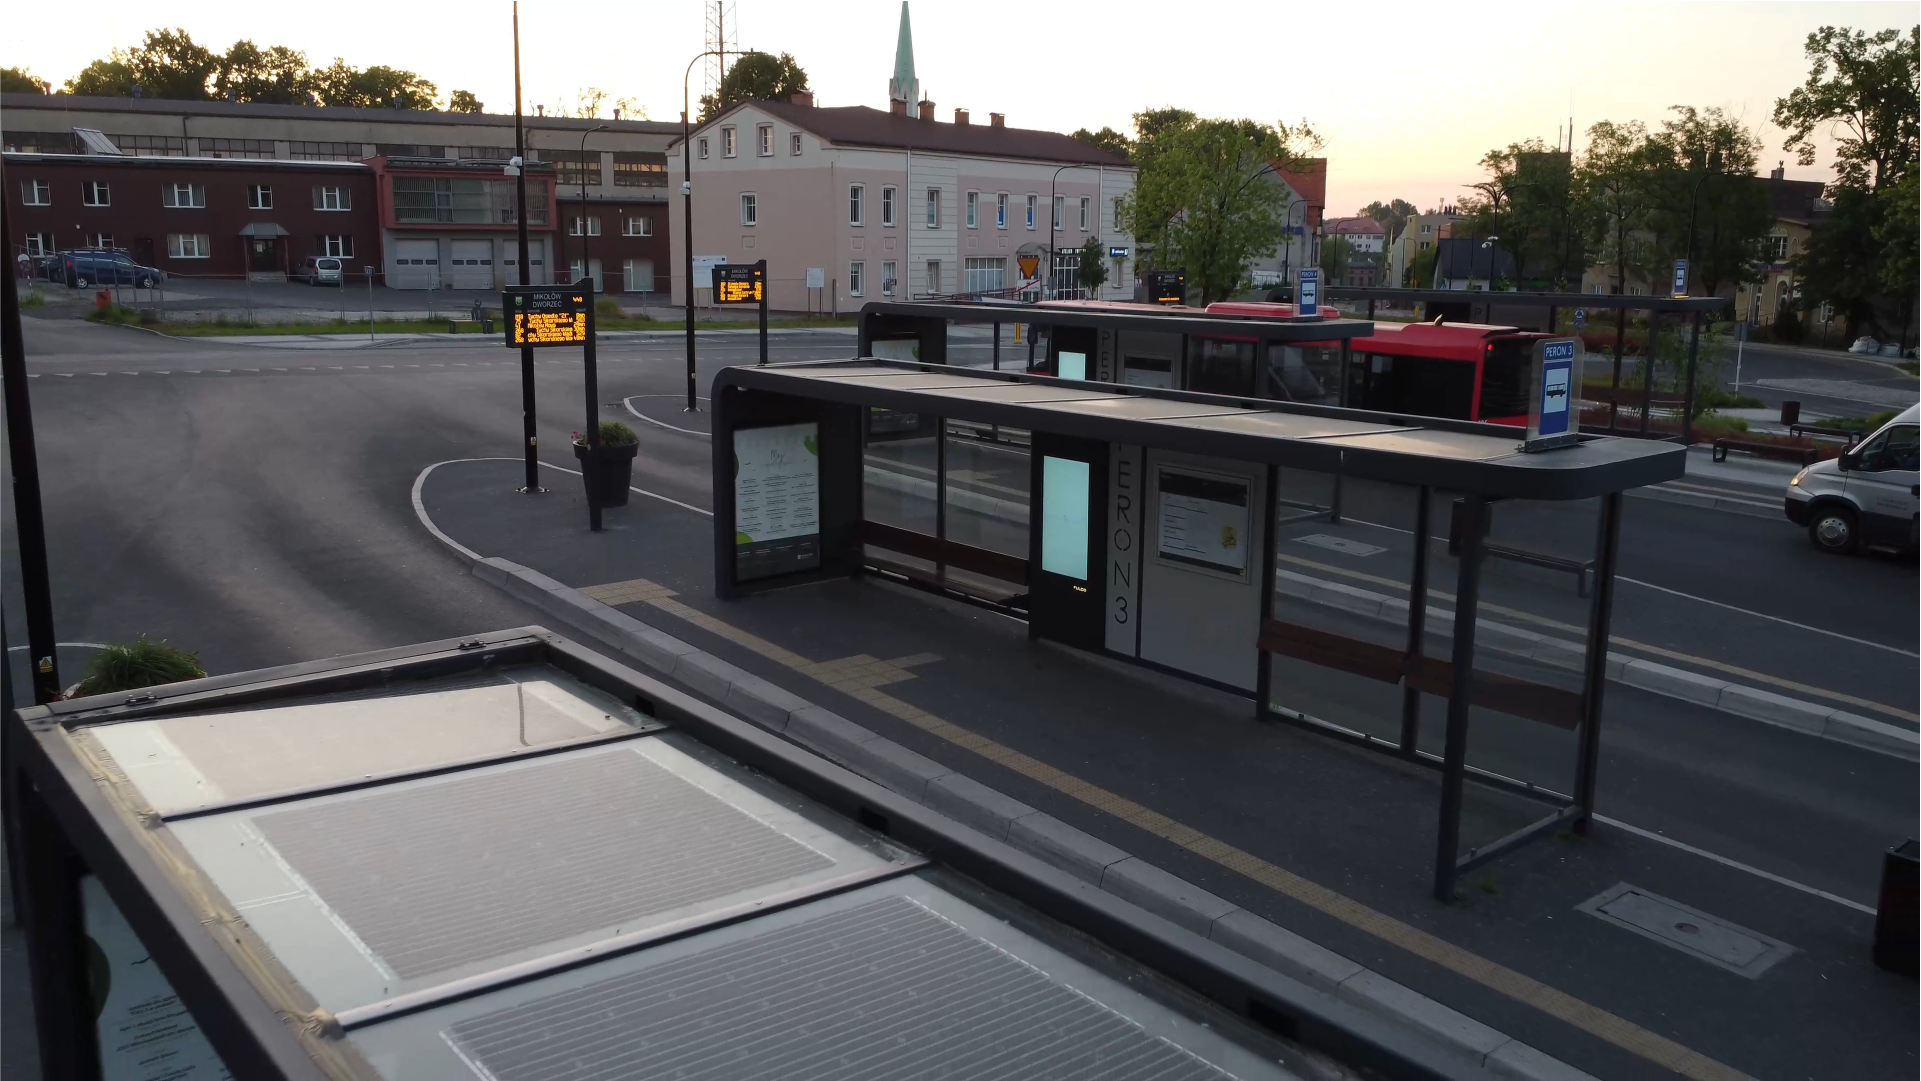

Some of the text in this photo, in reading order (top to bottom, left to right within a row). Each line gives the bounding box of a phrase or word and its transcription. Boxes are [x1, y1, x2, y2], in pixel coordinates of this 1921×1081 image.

[1546, 346, 1572, 357] PERON 3
[1114, 444, 1132, 624] ERON 3
